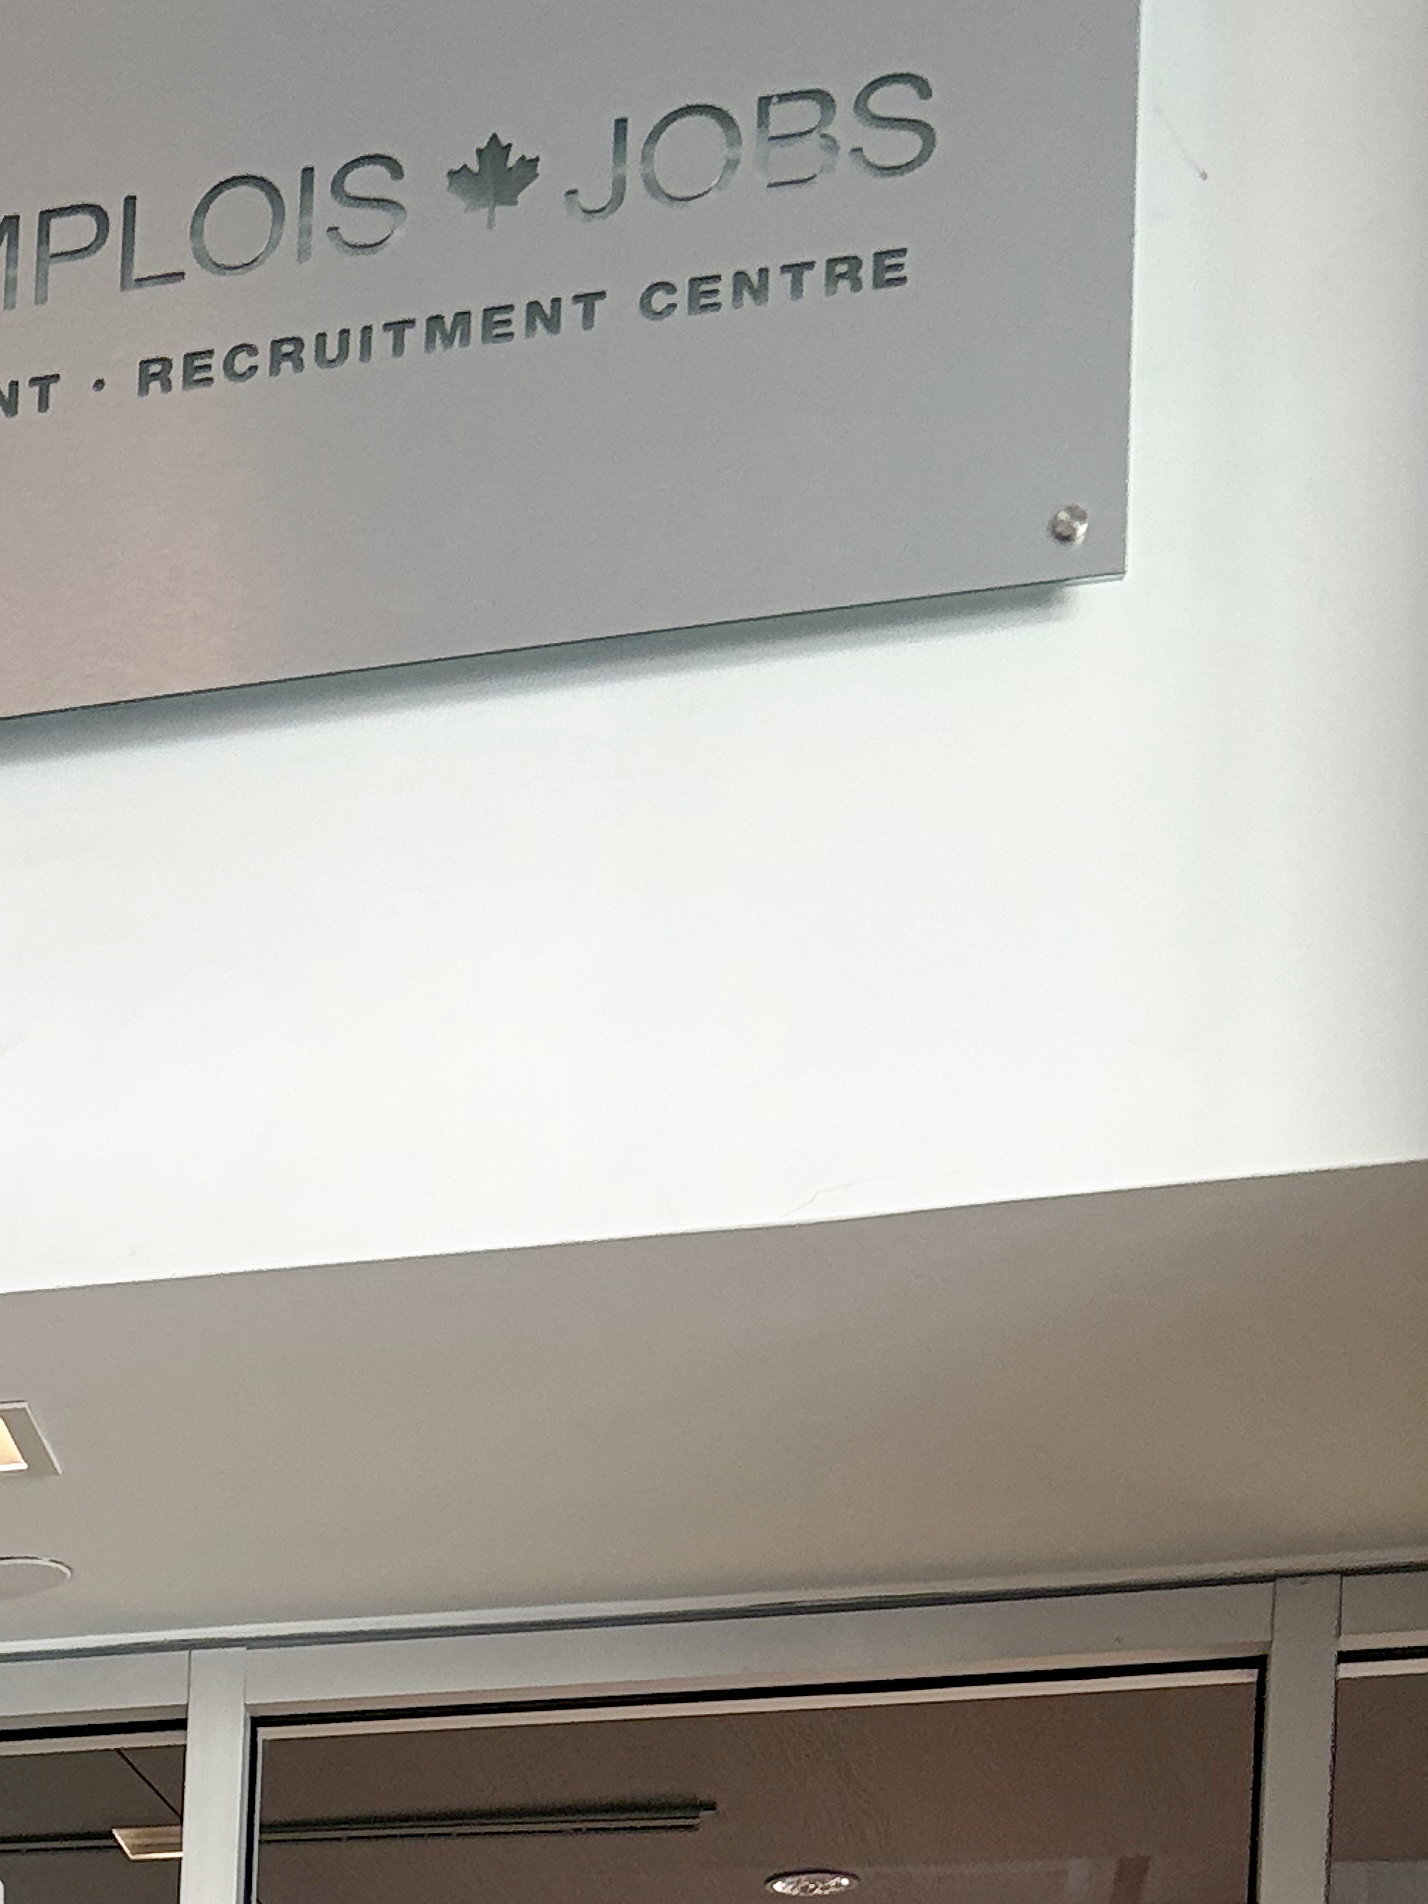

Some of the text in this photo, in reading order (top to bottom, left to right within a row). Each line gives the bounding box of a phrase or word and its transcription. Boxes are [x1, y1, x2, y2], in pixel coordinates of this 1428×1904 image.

[564, 72, 938, 222] JOBS
[137, 290, 608, 397] RECRUITMENT
[638, 247, 909, 322] CENTRE
